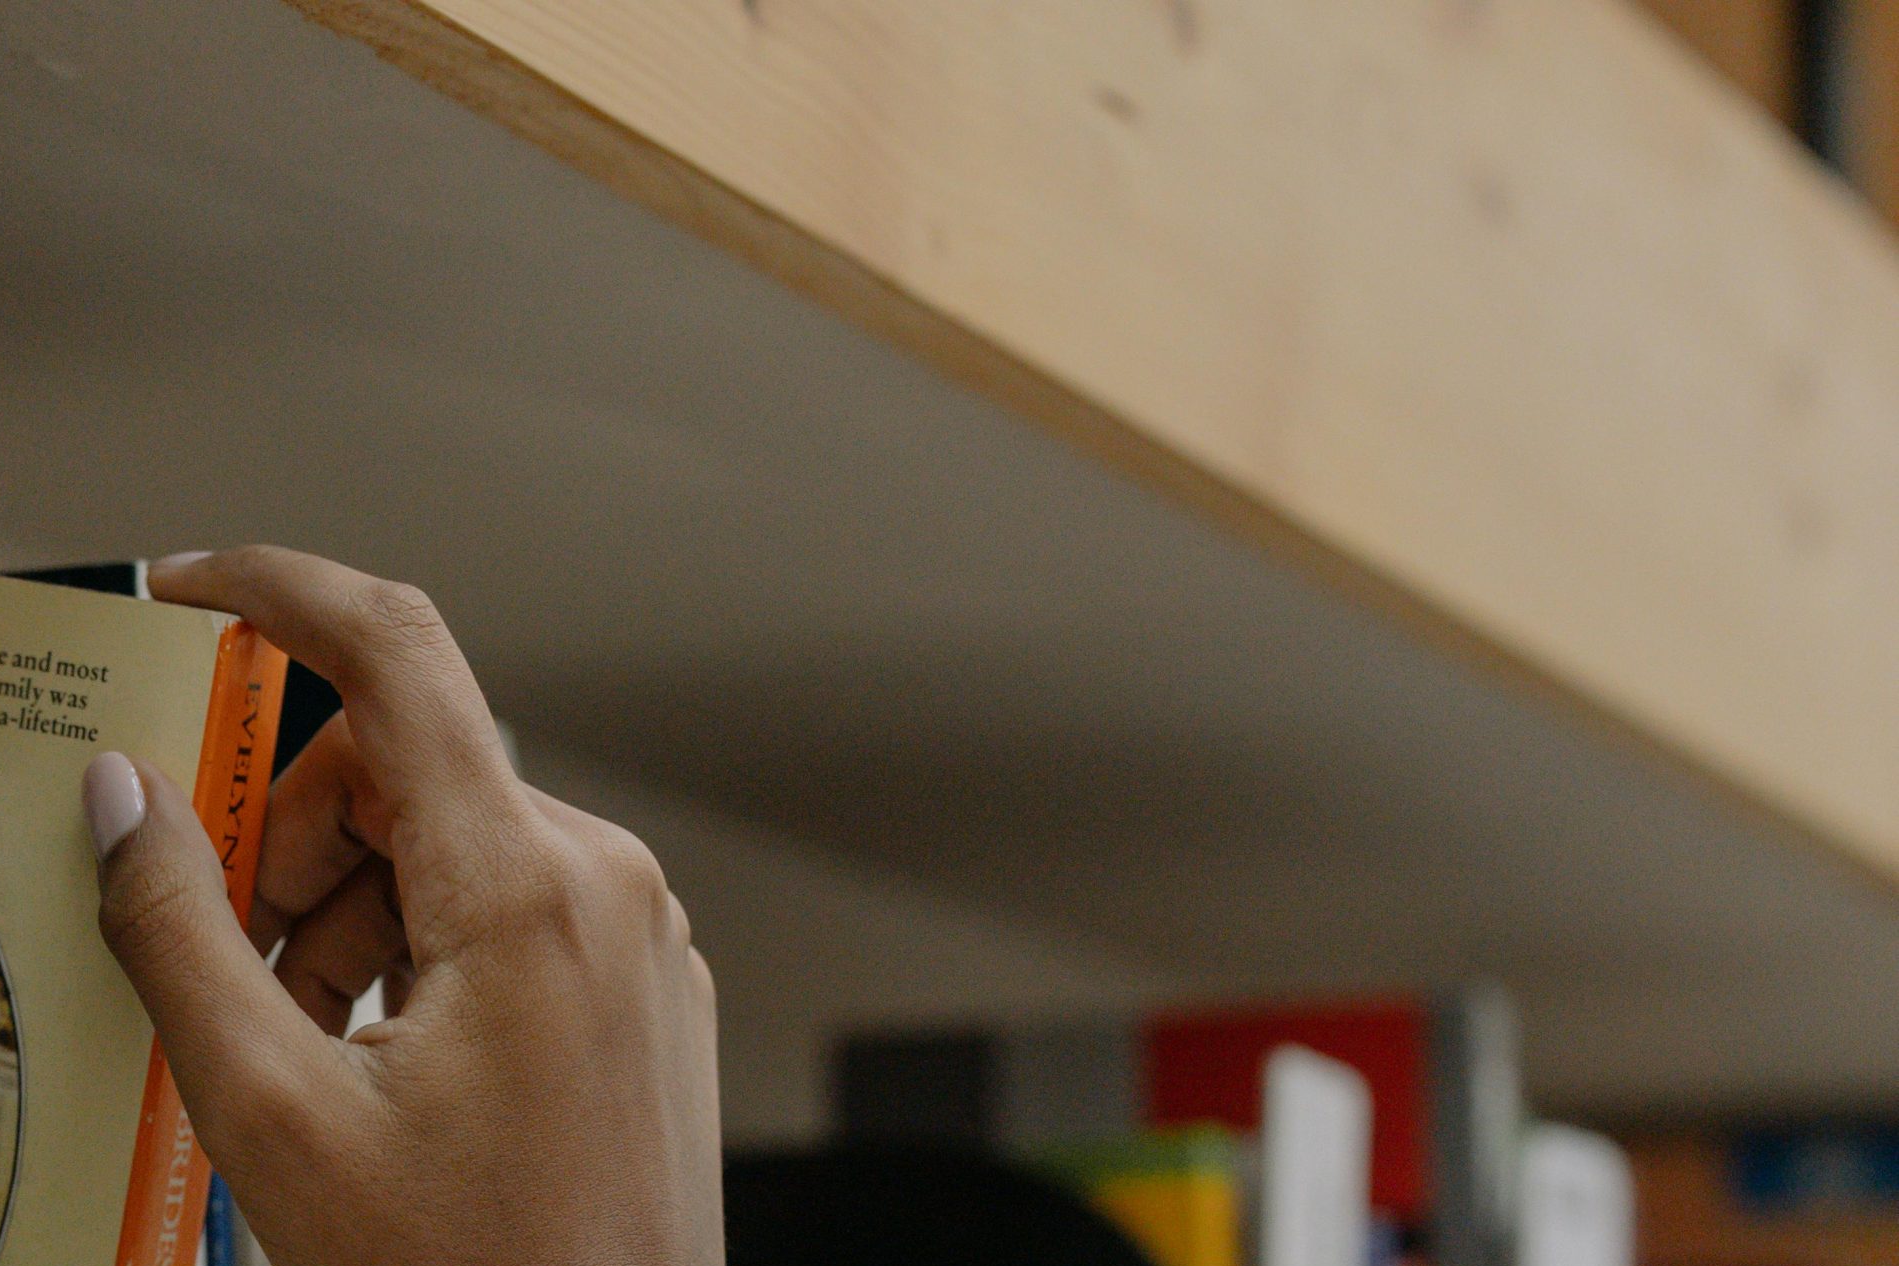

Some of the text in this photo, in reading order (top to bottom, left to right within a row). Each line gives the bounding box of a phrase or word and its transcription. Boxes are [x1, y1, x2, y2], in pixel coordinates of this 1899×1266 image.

[12, 652, 51, 673] and
[56, 661, 109, 683] most
[50, 687, 88, 711] was
[220, 682, 262, 872] EVELYN
